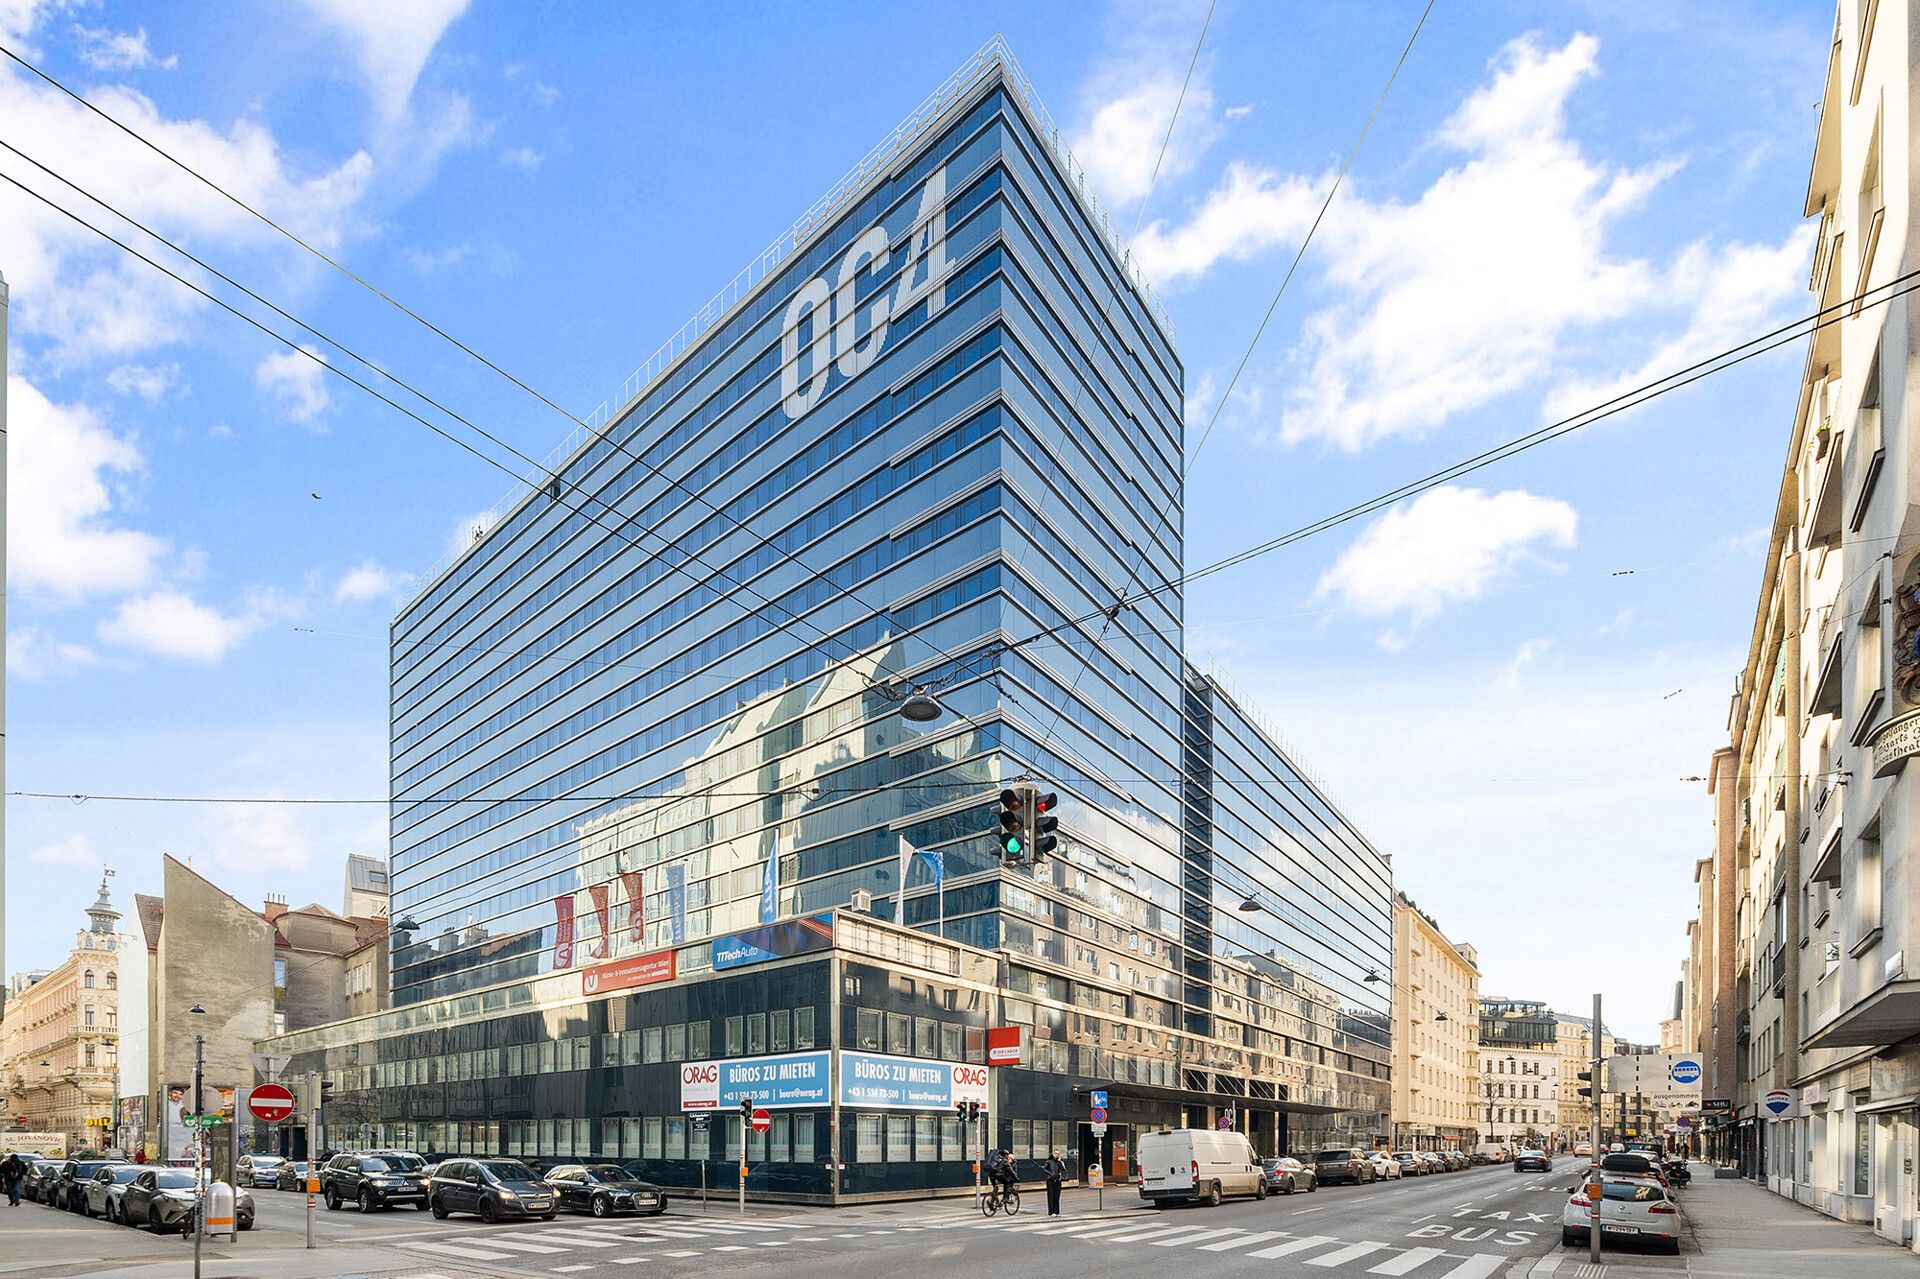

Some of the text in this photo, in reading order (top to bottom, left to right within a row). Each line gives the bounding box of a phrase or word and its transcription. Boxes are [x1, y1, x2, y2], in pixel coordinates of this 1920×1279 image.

[781, 161, 955, 419] OC4
[729, 1061, 816, 1083] BÜROS ZU MIETEN
[855, 1059, 941, 1085] BÜROS ZU MIETEN
[723, 1091, 734, 1100] +43
[847, 1087, 861, 1097] +43
[866, 1088, 878, 1098] 534
[878, 1088, 899, 1100] 73-500
[1405, 1224, 1539, 1246] BUS
